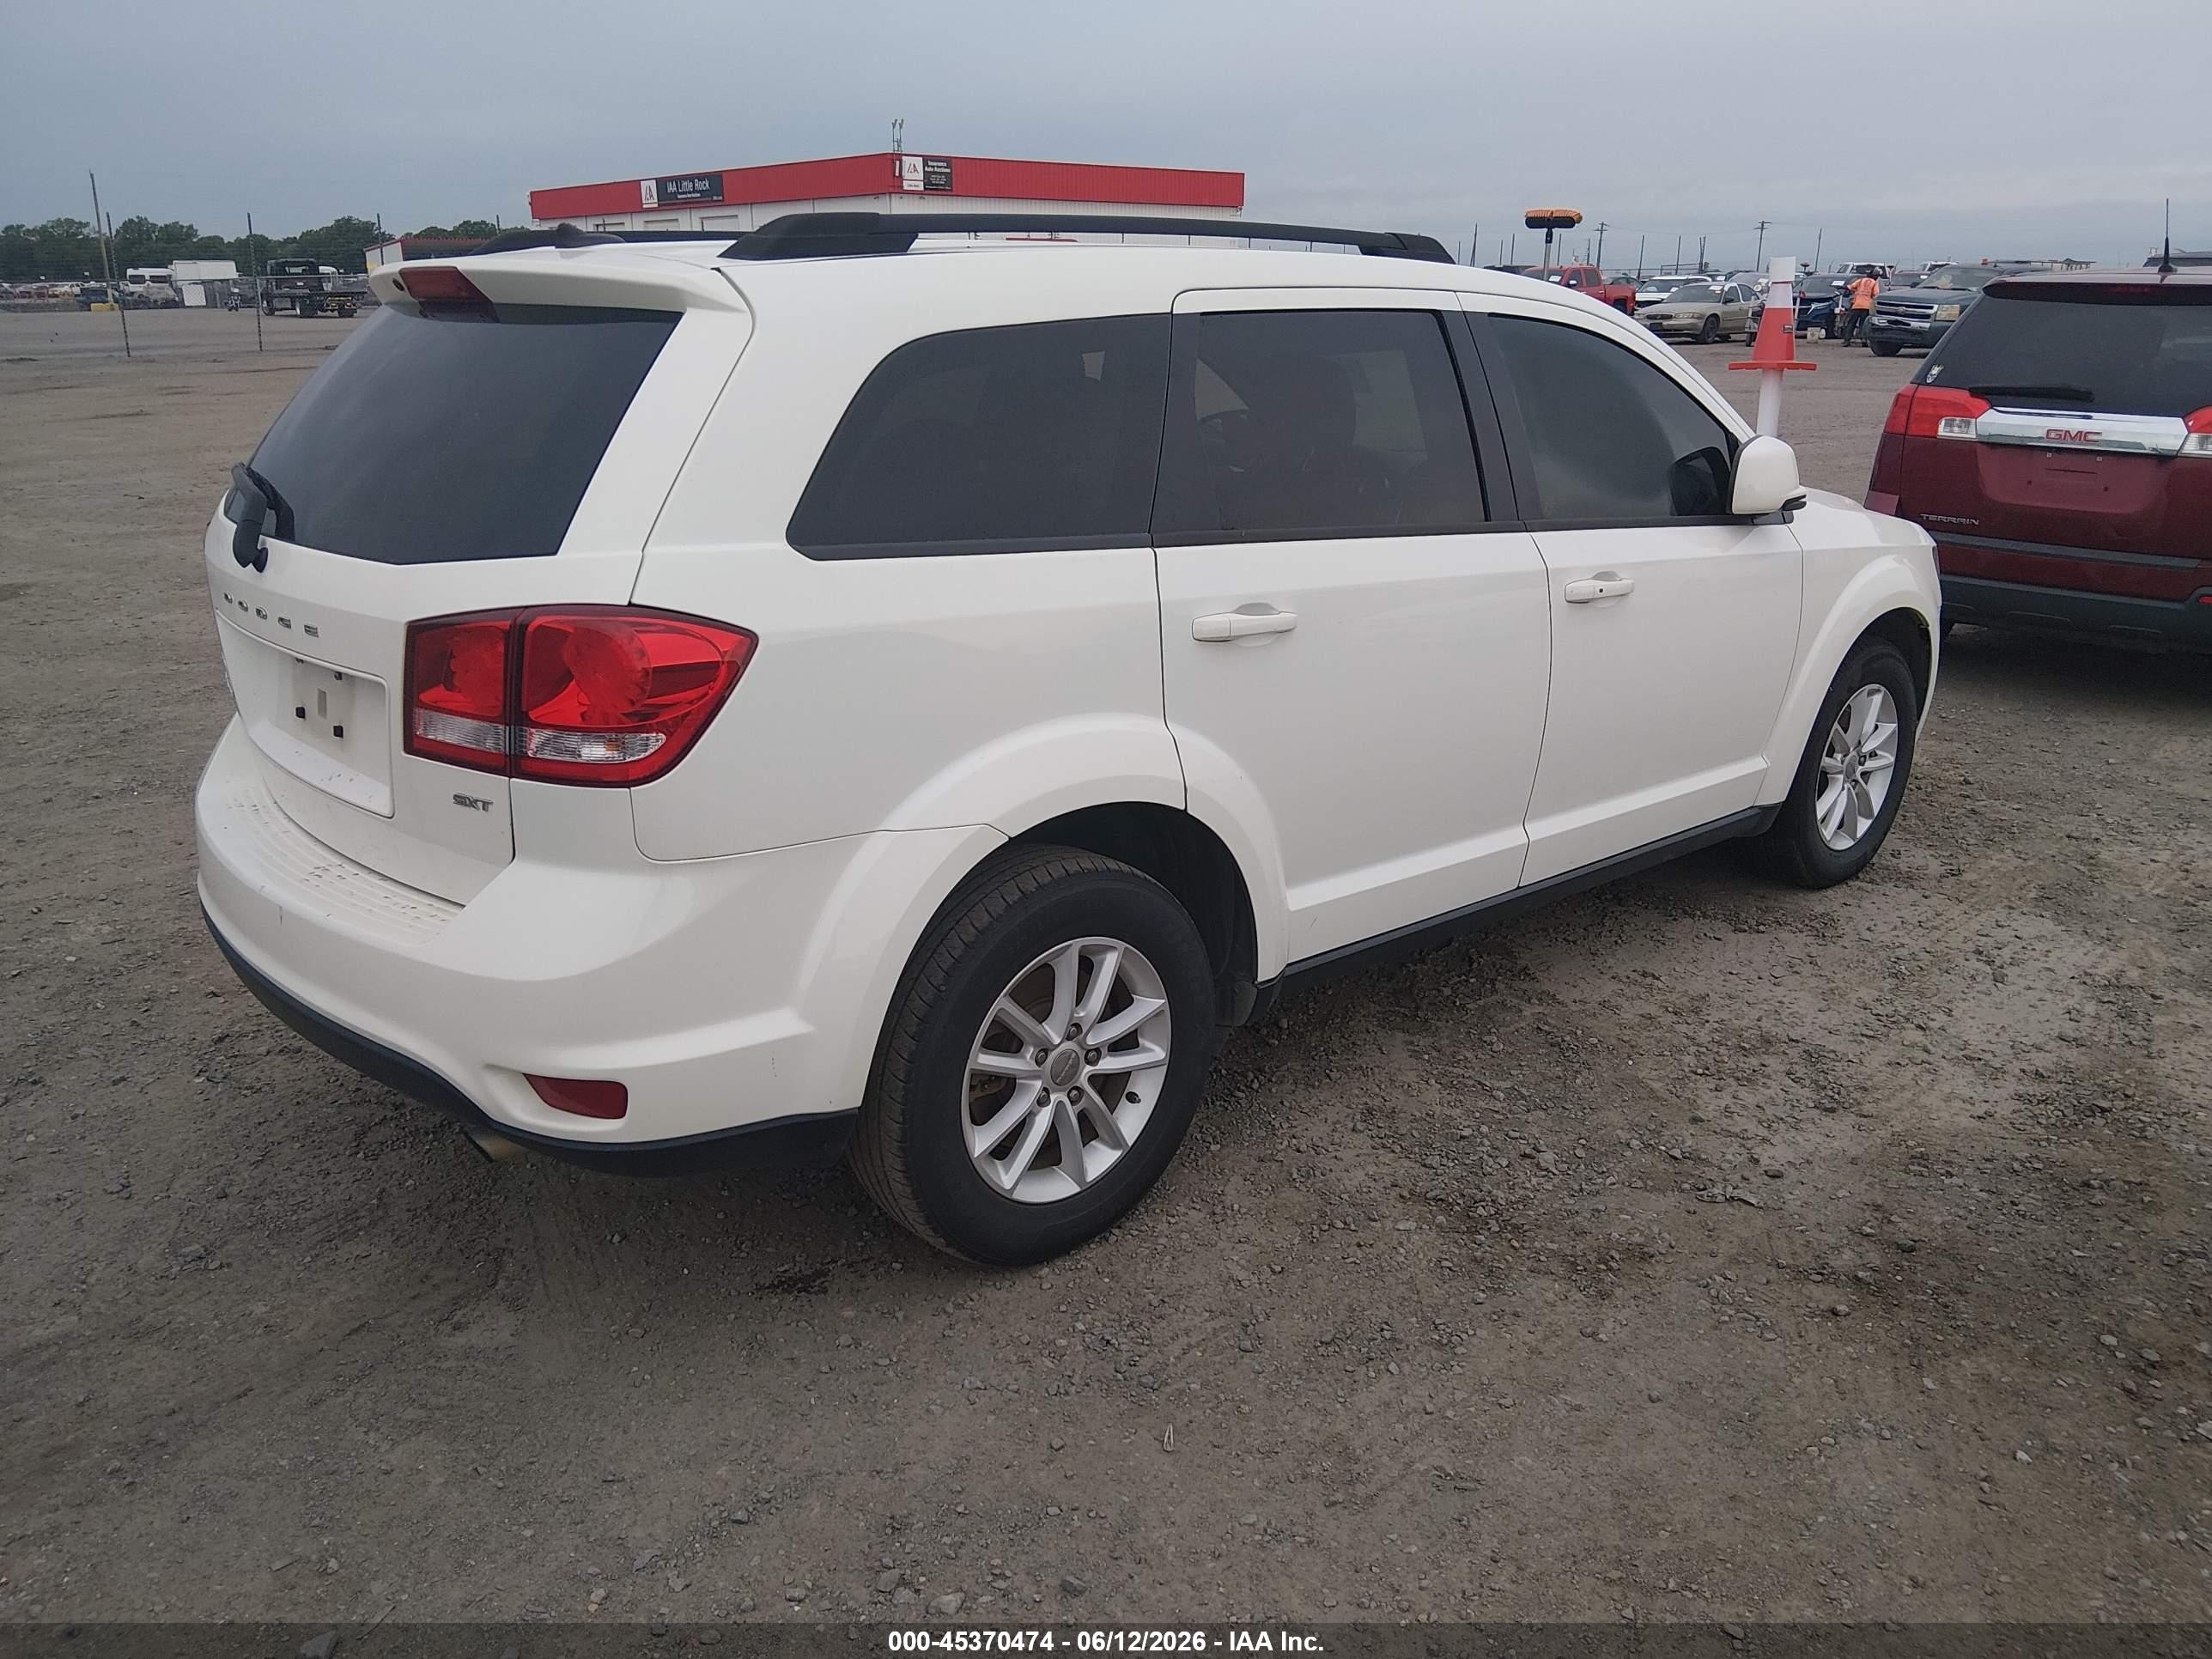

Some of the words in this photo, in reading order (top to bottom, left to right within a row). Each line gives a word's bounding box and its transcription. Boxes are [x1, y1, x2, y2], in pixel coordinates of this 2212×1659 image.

[666, 179, 678, 193] IAA
[678, 179, 694, 192] Little
[694, 178, 711, 191] Rock
[2046, 428, 2103, 443] GMC
[1919, 514, 1979, 526] TERRAIN
[453, 793, 495, 812] SXT
